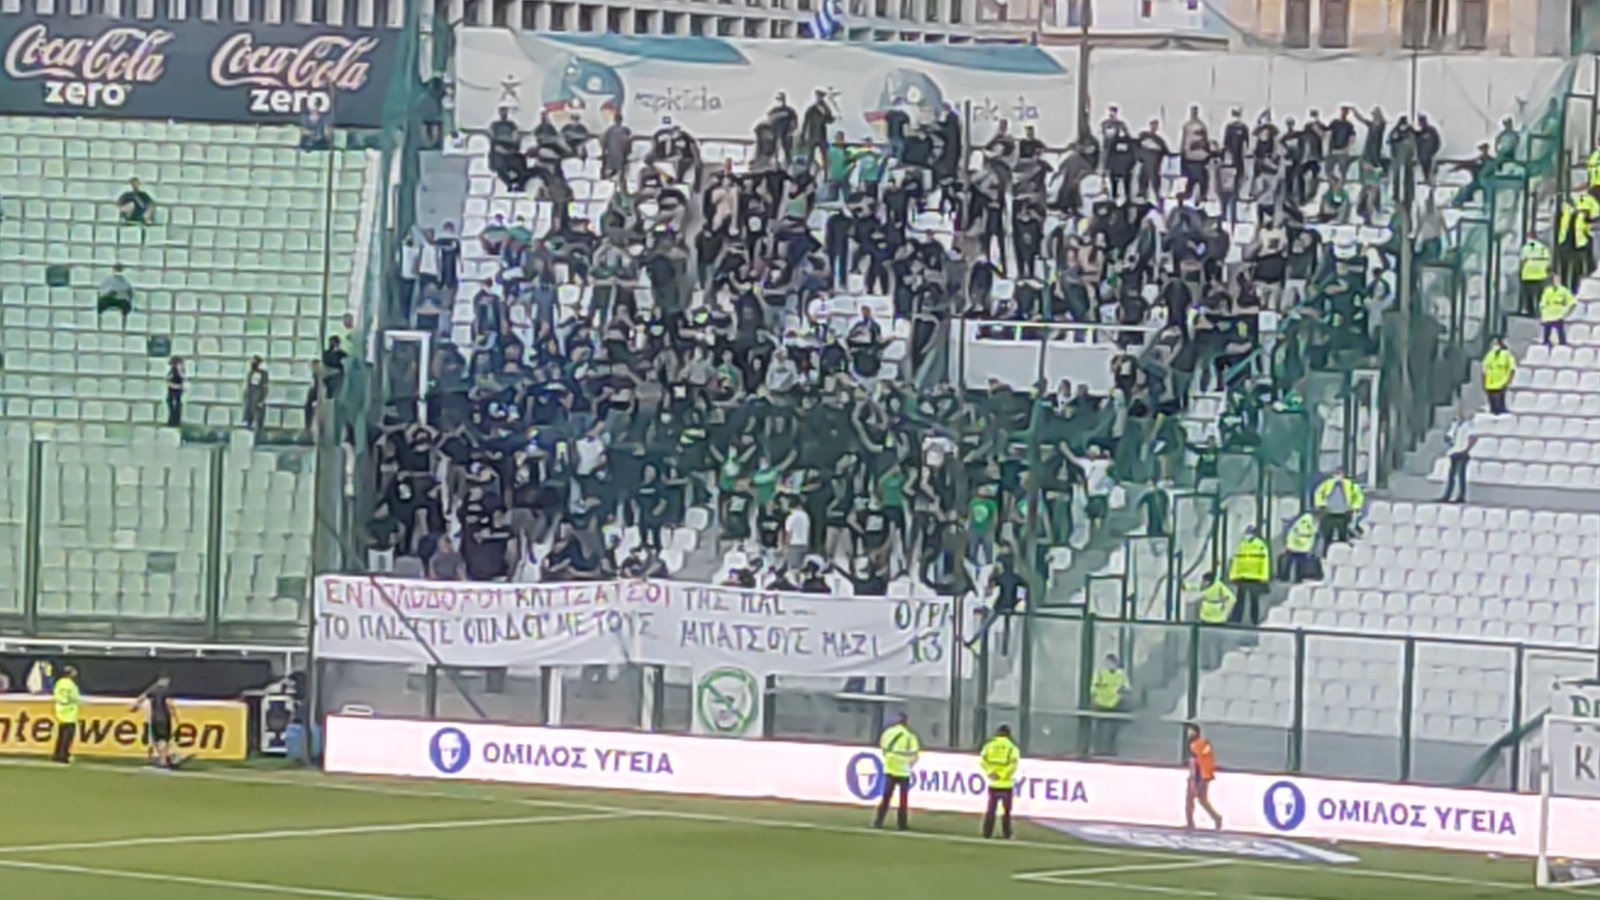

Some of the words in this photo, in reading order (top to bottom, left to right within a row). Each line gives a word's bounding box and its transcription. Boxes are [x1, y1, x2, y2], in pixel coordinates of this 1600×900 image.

[5, 24, 175, 82] Coca-Cola
[212, 33, 379, 91] Coca-Cola
[45, 81, 126, 107] zero
[250, 88, 330, 113] zero
[320, 612, 349, 640] ΤΟ
[908, 631, 943, 664] 13
[482, 742, 588, 768] ΟΜΙΛΟΣ
[594, 748, 674, 775] ΥΓΕΙΑ
[909, 768, 986, 796] ΜΙΛΟ
[1013, 776, 1088, 804] ΥΓΕΙΑ
[1317, 797, 1427, 828] ΟΜΙΛΟΣ
[1434, 805, 1517, 836] ΥΓΕΙΑ
